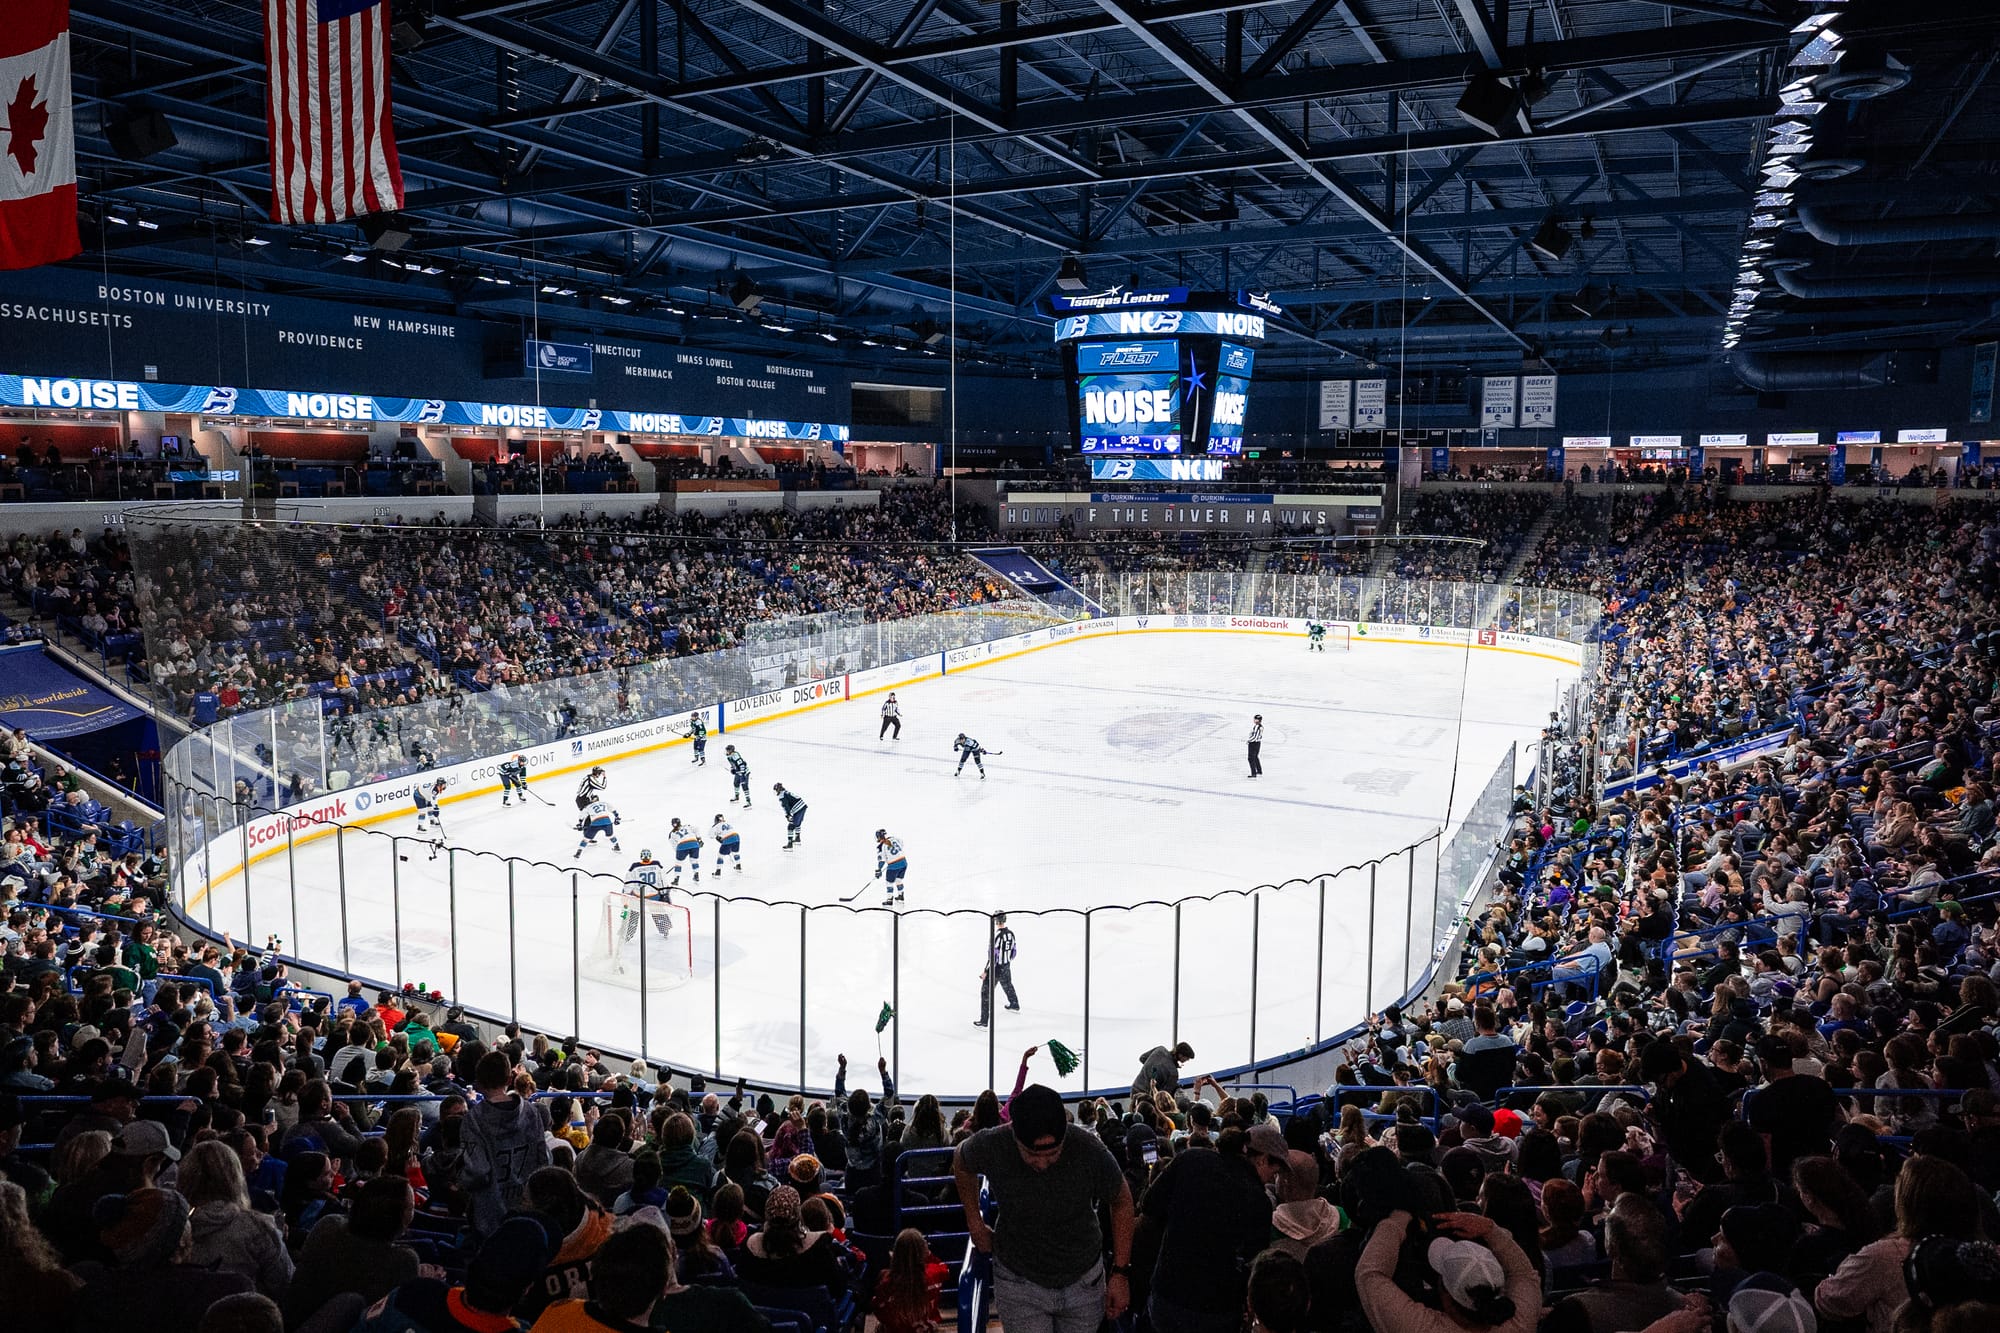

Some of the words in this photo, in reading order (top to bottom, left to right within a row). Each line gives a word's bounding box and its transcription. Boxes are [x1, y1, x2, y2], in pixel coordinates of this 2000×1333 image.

[98, 285, 165, 306] BOSTON
[174, 294, 271, 317] UNIVERSITY
[1068, 296, 1121, 308] Tsongas
[1121, 291, 1170, 304] Center
[0, 303, 133, 329] SSACHUSETTS
[353, 315, 381, 329] NEW
[388, 319, 456, 338] HAMPSHIRE
[278, 330, 363, 350] PROVIDENCE
[583, 342, 642, 359] NNECTICUT
[1099, 351, 1160, 366] FLEET
[677, 354, 703, 366] UMASS
[705, 357, 734, 369] LOWELL
[625, 366, 673, 379] MERRIMACK
[766, 364, 814, 378] NORTHEASTERN
[716, 375, 744, 387] BOSTON
[746, 378, 776, 390] COLLEGE
[807, 385, 827, 395] MAINE
[1486, 379, 1513, 387] HOCKEY
[1526, 378, 1553, 386] HOCKEY
[22, 378, 139, 410] NOISE
[287, 394, 373, 420] NOISE
[1085, 389, 1172, 424] NOISE
[1212, 391, 1247, 426] NOISE
[482, 405, 547, 427] NOISE
[629, 413, 681, 433] NOISE
[745, 420, 787, 438] NOISE
[1907, 433, 1936, 442] Wellpoint
[1101, 438, 1108, 451] 1
[1120, 435, 1140, 445] 9:29
[1152, 438, 1162, 451] 0
[1007, 508, 1062, 524] HOME
[1075, 508, 1097, 523] OF
[1112, 508, 1149, 523] THE
[1164, 508, 1229, 523] RIVER
[1246, 508, 1327, 525] HAWKS
[1230, 616, 1289, 630] Scotiabank
[1500, 634, 1531, 643] PAVING
[948, 646, 982, 664] NETSCUT
[33, 687, 89, 705] worldwide
[793, 680, 841, 704] DISCOVER
[734, 691, 782, 713] LOVERING
[587, 734, 625, 752] MANNING
[626, 728, 654, 742] SCHOOL
[655, 724, 665, 735] OF
[375, 784, 411, 804] bread
[592, 803, 606, 814] 27
[248, 798, 348, 849] Scotiabank
[638, 871, 656, 886] 30
[495, 1143, 531, 1183] 37
